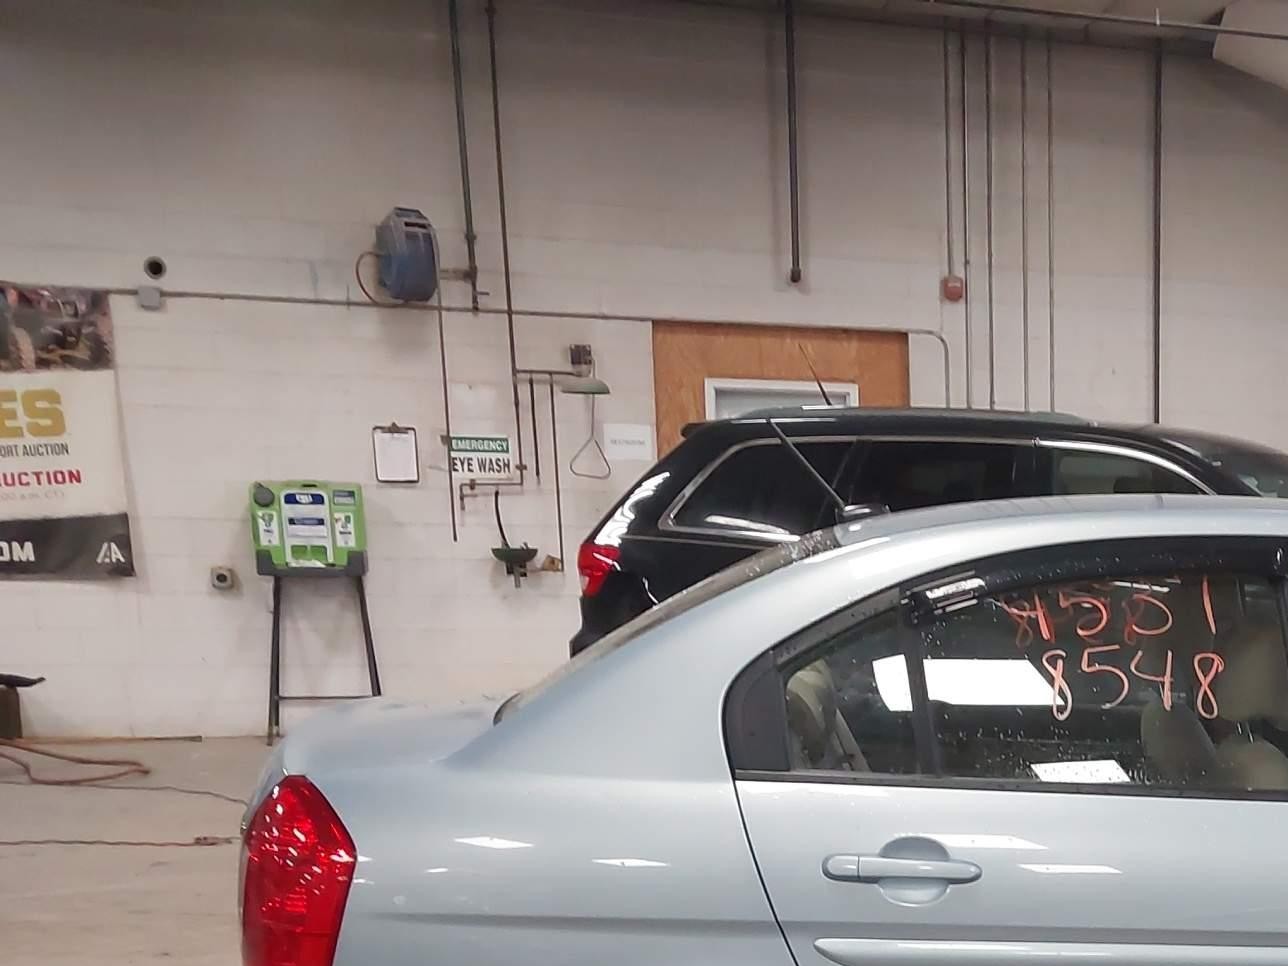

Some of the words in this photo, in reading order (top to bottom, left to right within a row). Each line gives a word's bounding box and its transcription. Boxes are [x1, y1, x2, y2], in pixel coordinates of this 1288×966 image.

[22, 441, 70, 456] AUCTION
[452, 439, 508, 451] EMERGENCY
[452, 456, 474, 473] EYE
[477, 457, 512, 474] WASH
[0, 469, 82, 487] UCTION
[1041, 643, 1226, 722] 8548
